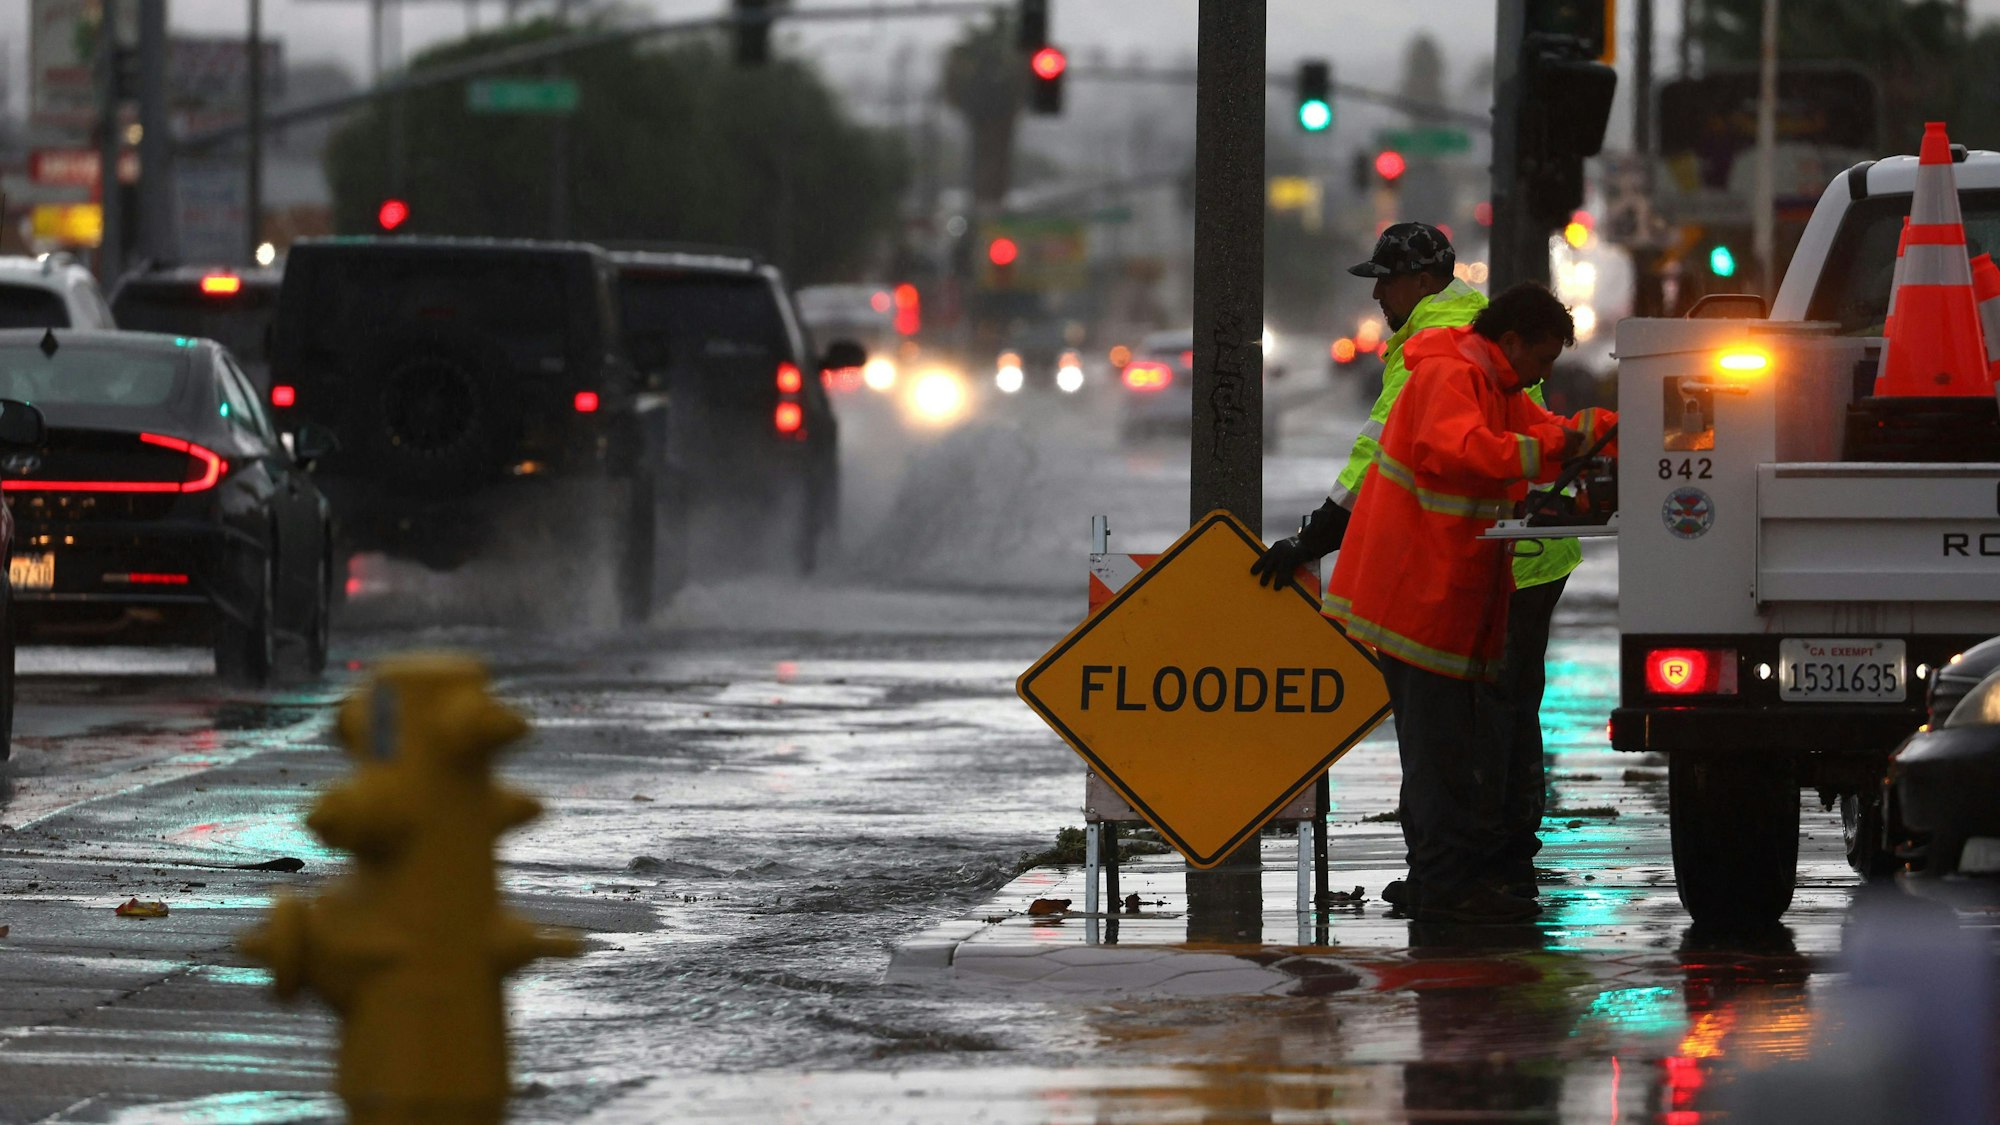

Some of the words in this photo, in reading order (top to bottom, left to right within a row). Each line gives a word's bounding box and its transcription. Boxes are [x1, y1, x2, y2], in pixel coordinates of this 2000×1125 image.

[1658, 458, 1713, 480] 842
[1810, 647, 1825, 657] CA
[1831, 647, 1874, 657] EXEMPT
[1669, 665, 1683, 677] R
[1788, 663, 1897, 693] 1531635
[1080, 664, 1345, 713] FLOODED
